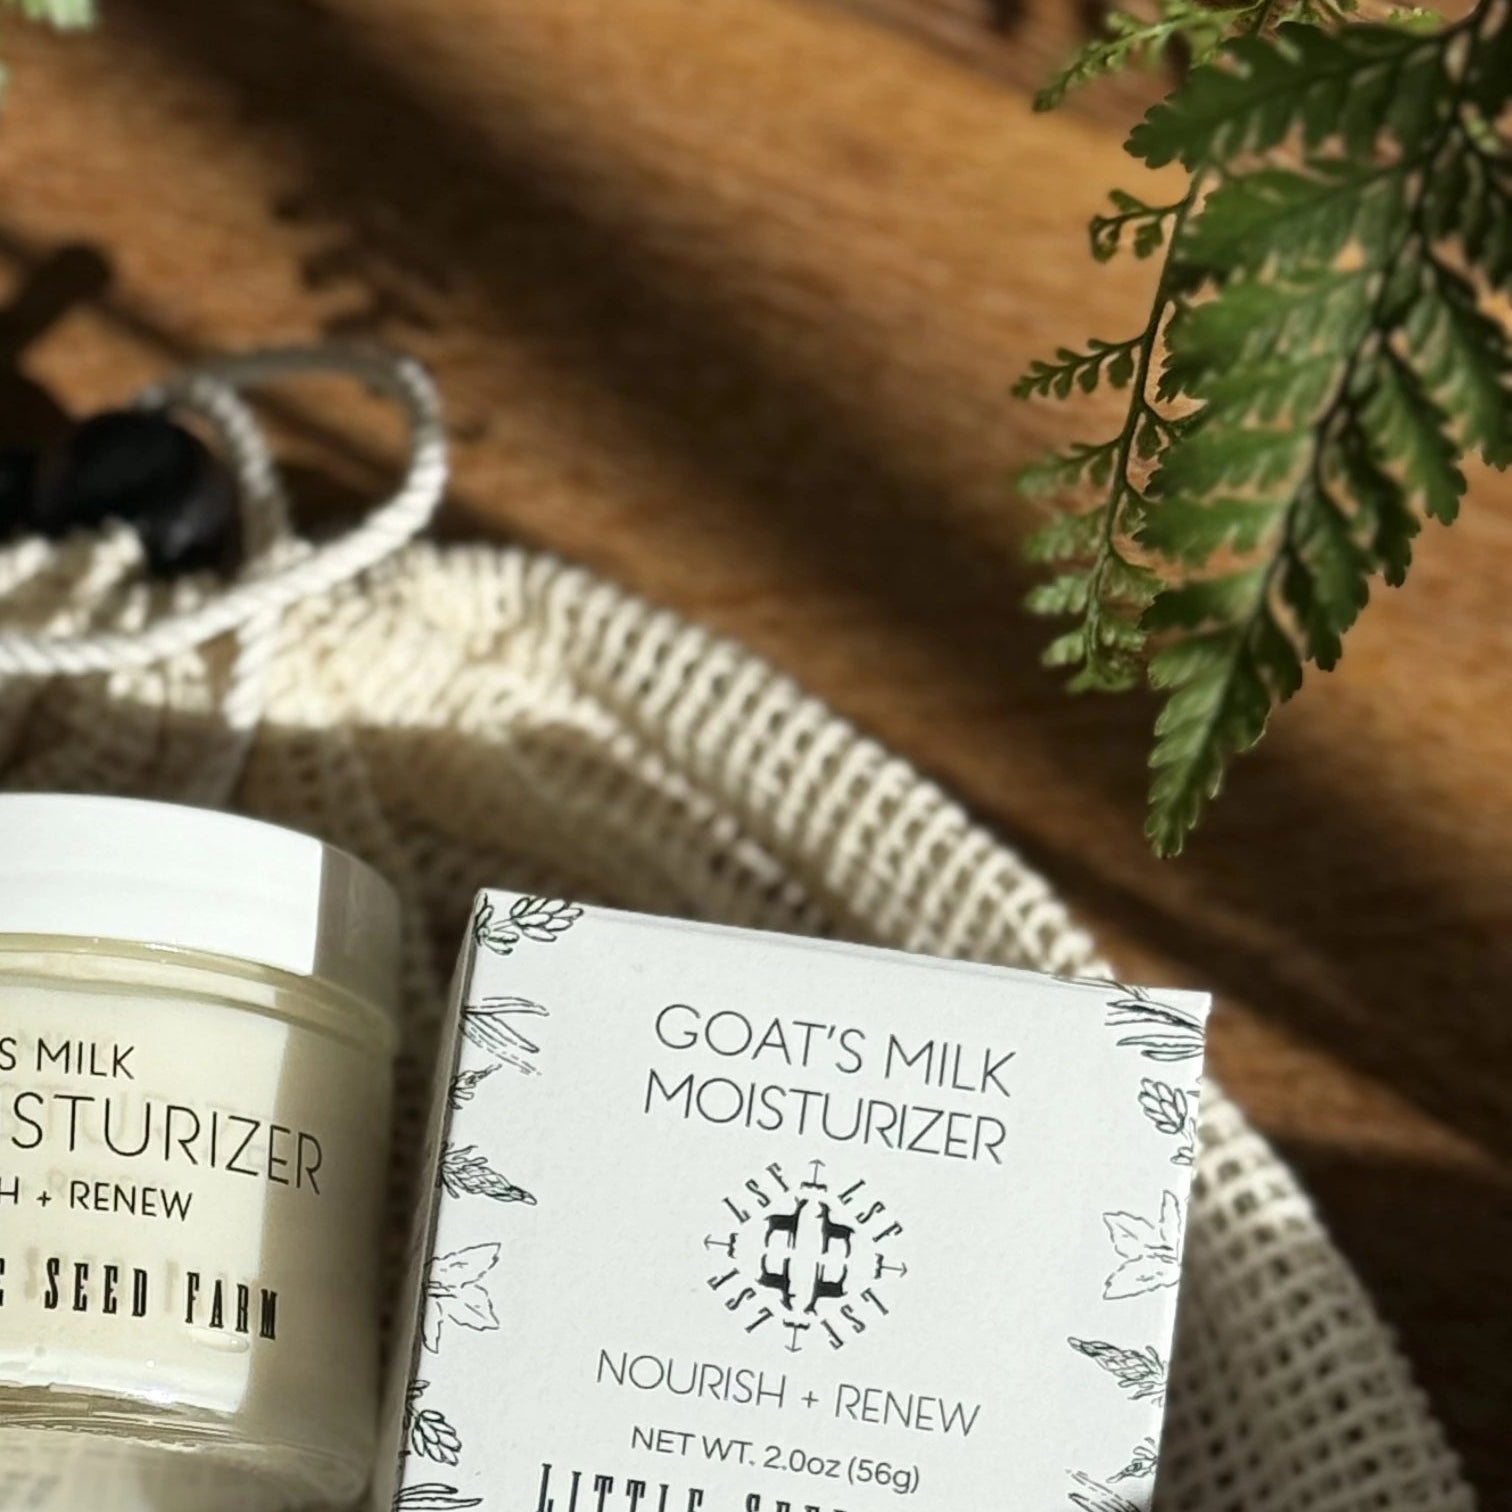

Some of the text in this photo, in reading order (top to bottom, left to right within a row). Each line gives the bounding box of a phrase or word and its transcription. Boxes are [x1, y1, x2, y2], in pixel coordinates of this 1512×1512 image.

[36, 1038, 135, 1079] MILK
[656, 1004, 1016, 1097] GOAT'S MILK
[645, 1068, 1006, 1165] MOISTURIZER
[70, 1181, 192, 1221] RENEW
[44, 1257, 147, 1317] SEED
[185, 1271, 278, 1340] FARM
[596, 1349, 787, 1408] NOURISH
[835, 1383, 980, 1436] RENEW
[632, 1426, 920, 1494] NET WT. 2.0oz (56g)
